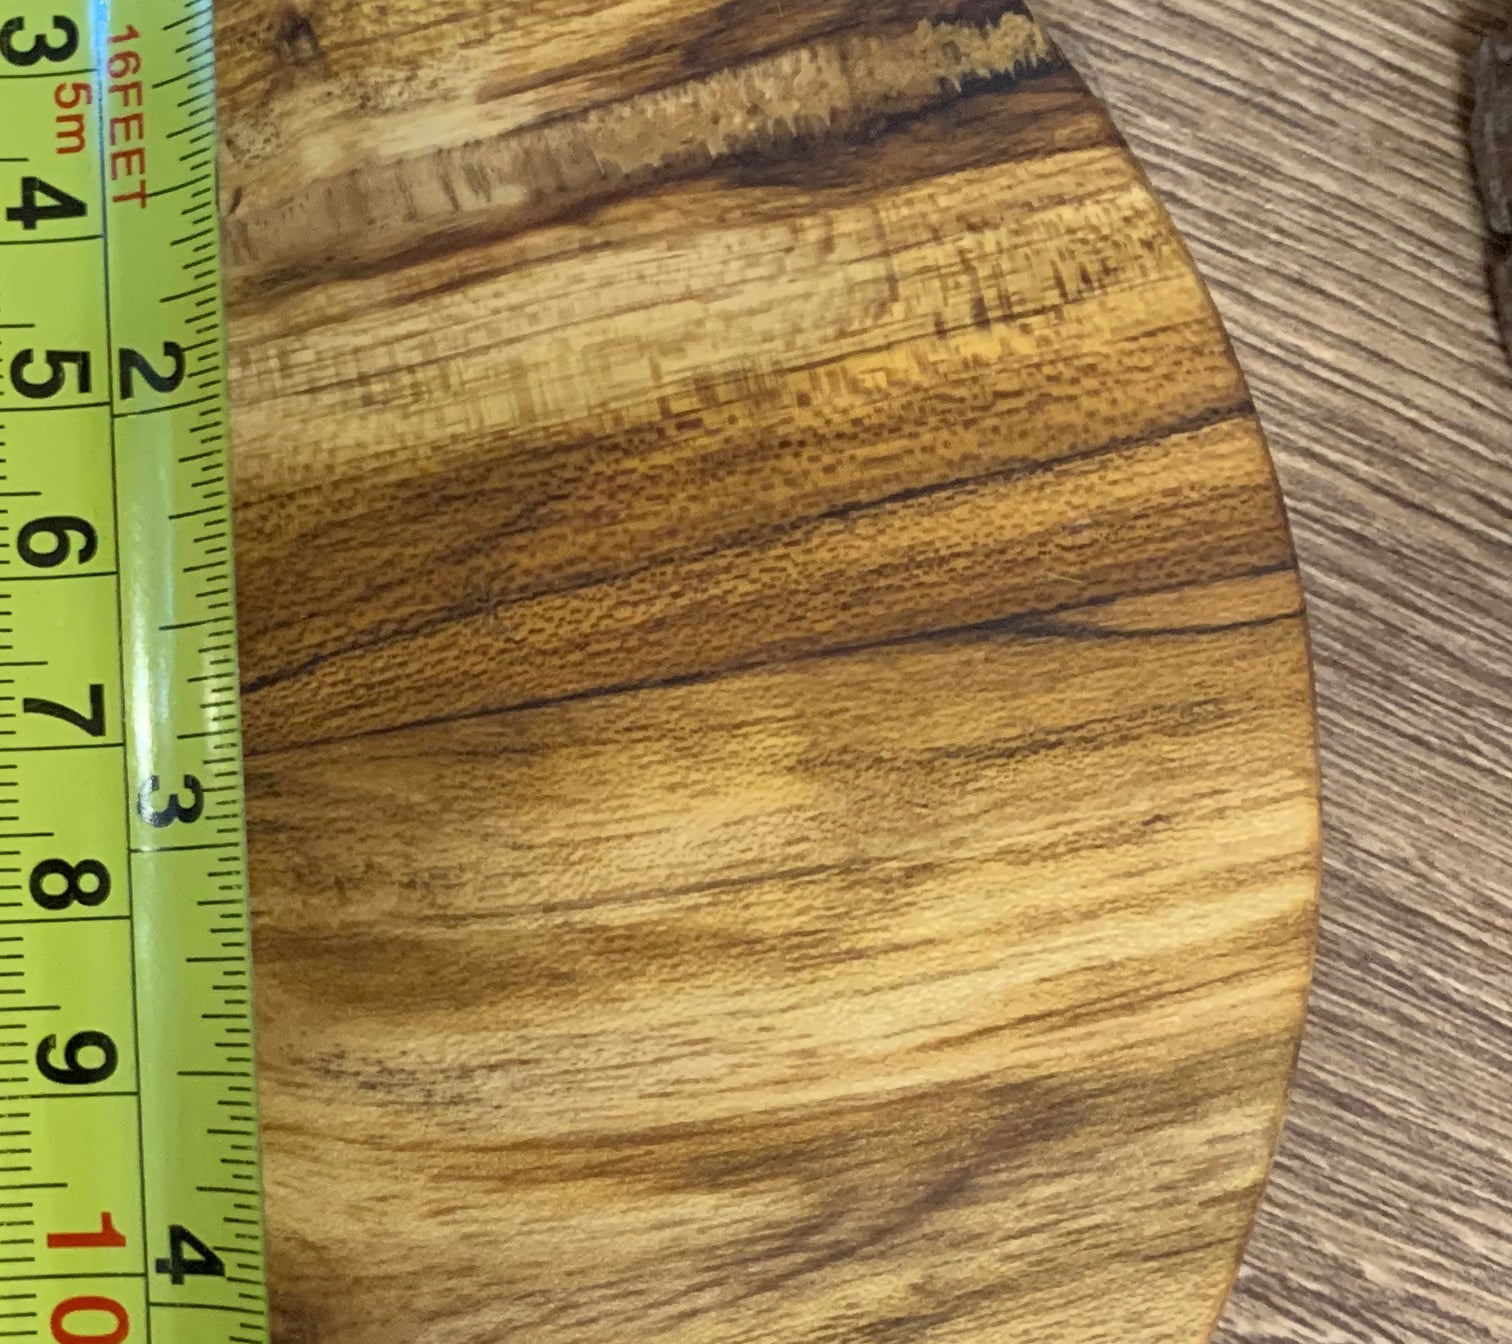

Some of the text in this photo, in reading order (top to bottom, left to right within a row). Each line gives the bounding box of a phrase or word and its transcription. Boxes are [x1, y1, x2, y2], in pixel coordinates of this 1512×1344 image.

[54, 82, 93, 155] 5m
[6, 176, 87, 230] 4
[10, 348, 92, 399] 5
[118, 341, 187, 399] 2
[16, 515, 98, 568] 6
[22, 683, 107, 737] 7
[137, 774, 205, 828] 3
[29, 858, 111, 910] 8
[35, 1030, 119, 1085] 9
[155, 1224, 227, 1285] 4
